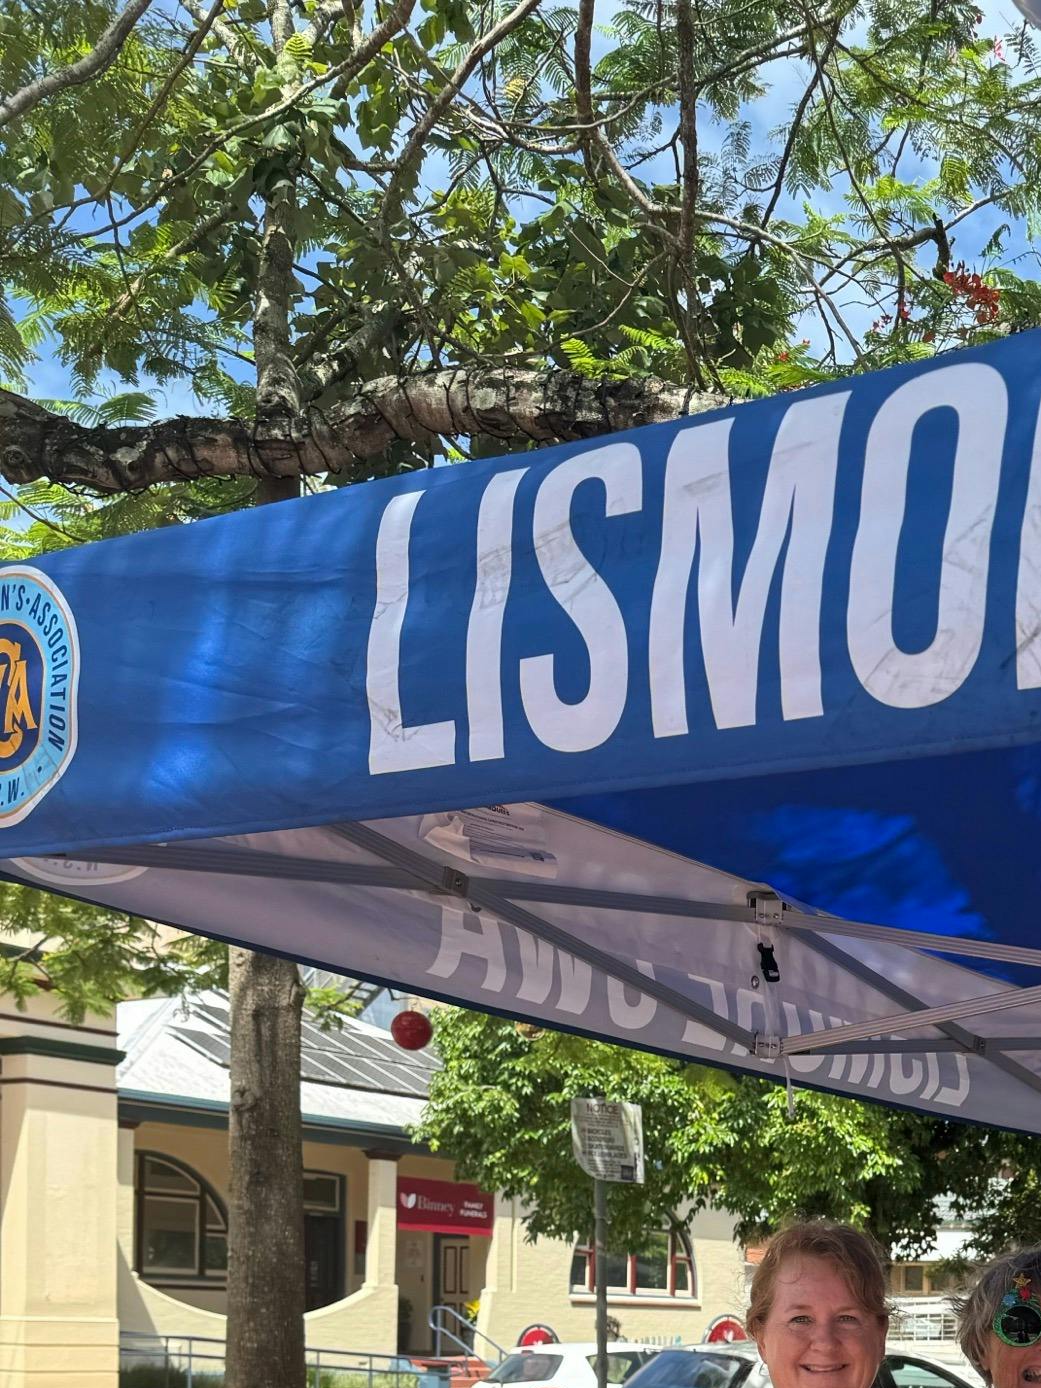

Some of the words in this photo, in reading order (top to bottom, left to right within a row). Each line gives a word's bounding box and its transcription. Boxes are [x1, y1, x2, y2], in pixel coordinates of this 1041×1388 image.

[29, 592, 69, 752] ASSOCIATION
[586, 1103, 619, 1115] NOTICE
[418, 1195, 454, 1217] Binney
[463, 1201, 484, 1210] FAMILY
[459, 1209, 488, 1219] FUNERALS
